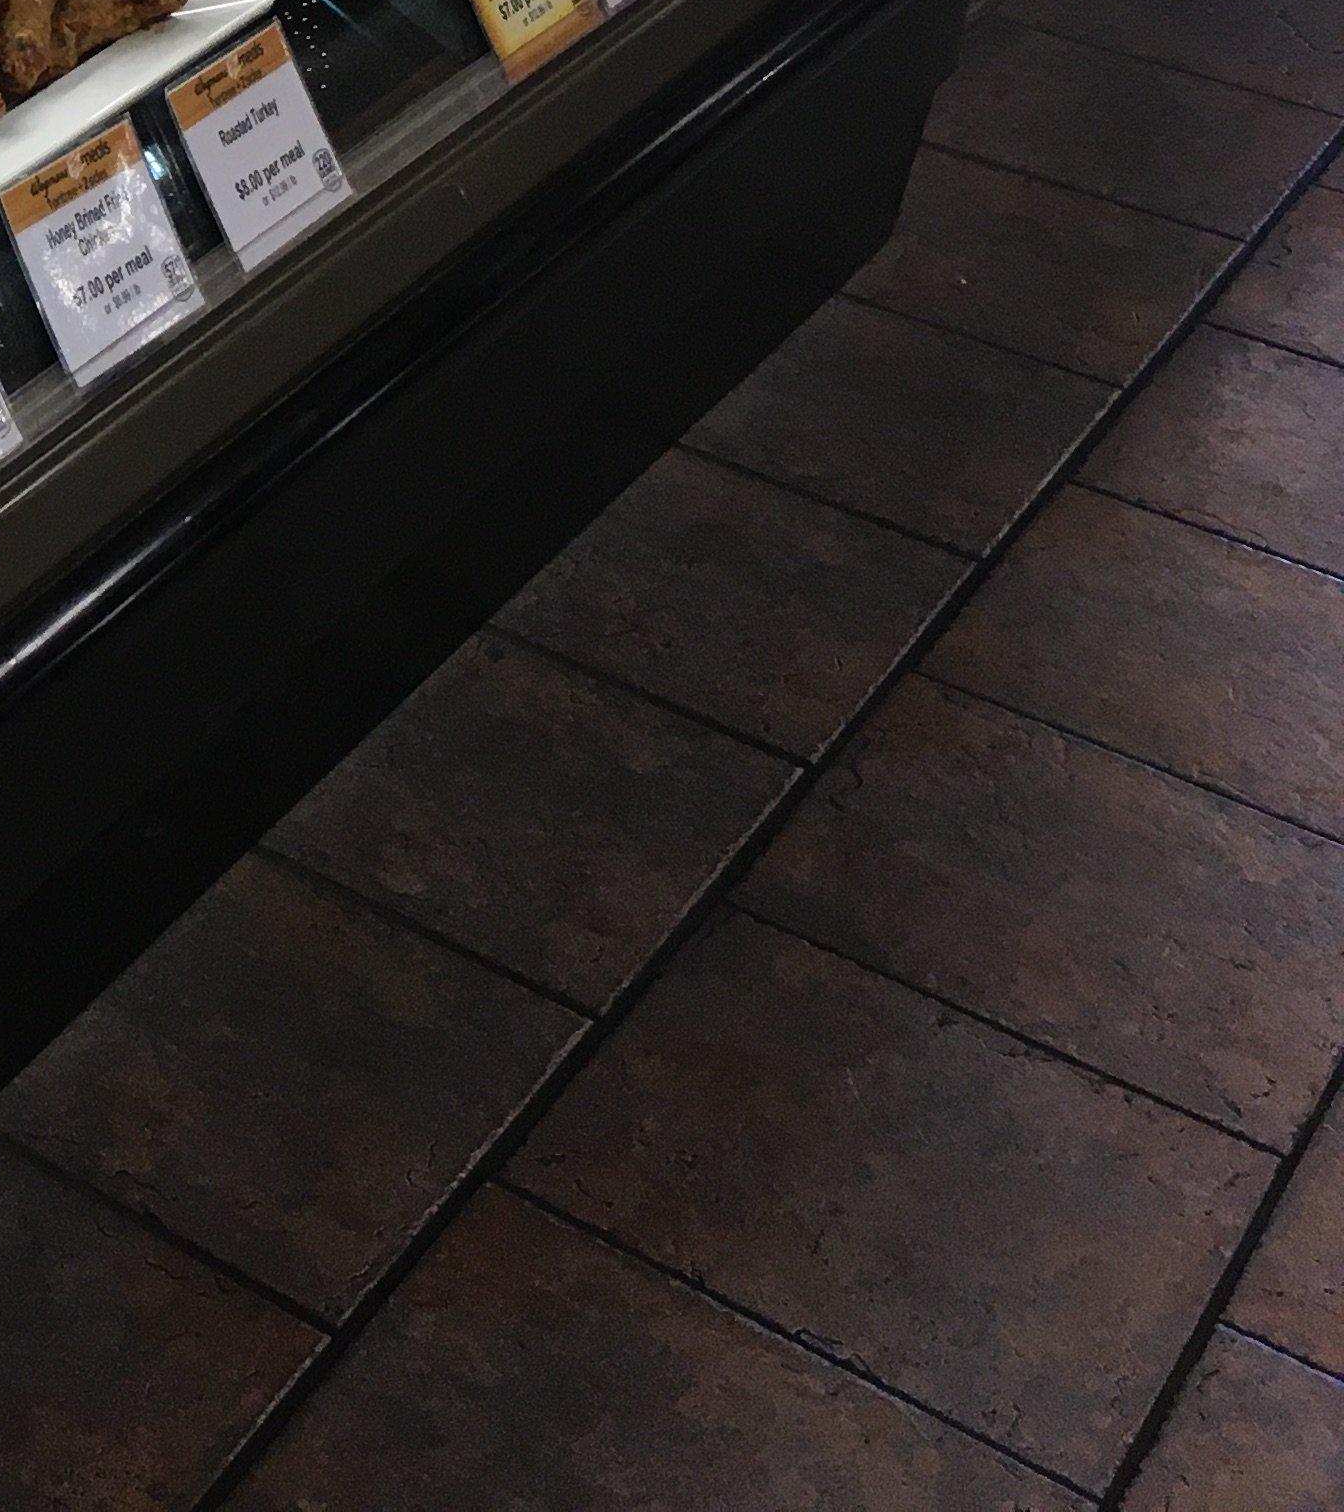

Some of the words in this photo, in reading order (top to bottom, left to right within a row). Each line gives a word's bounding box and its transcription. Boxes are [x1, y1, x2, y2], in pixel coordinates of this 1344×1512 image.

[218, 114, 253, 147] Roasted
[250, 99, 279, 125] Turkey
[262, 160, 280, 185] per
[280, 140, 305, 168] meal
[46, 221, 77, 249] Honey
[74, 199, 106, 231] Brined
[74, 276, 105, 306] $7.00
[105, 266, 124, 293] per
[125, 245, 153, 276] meal
